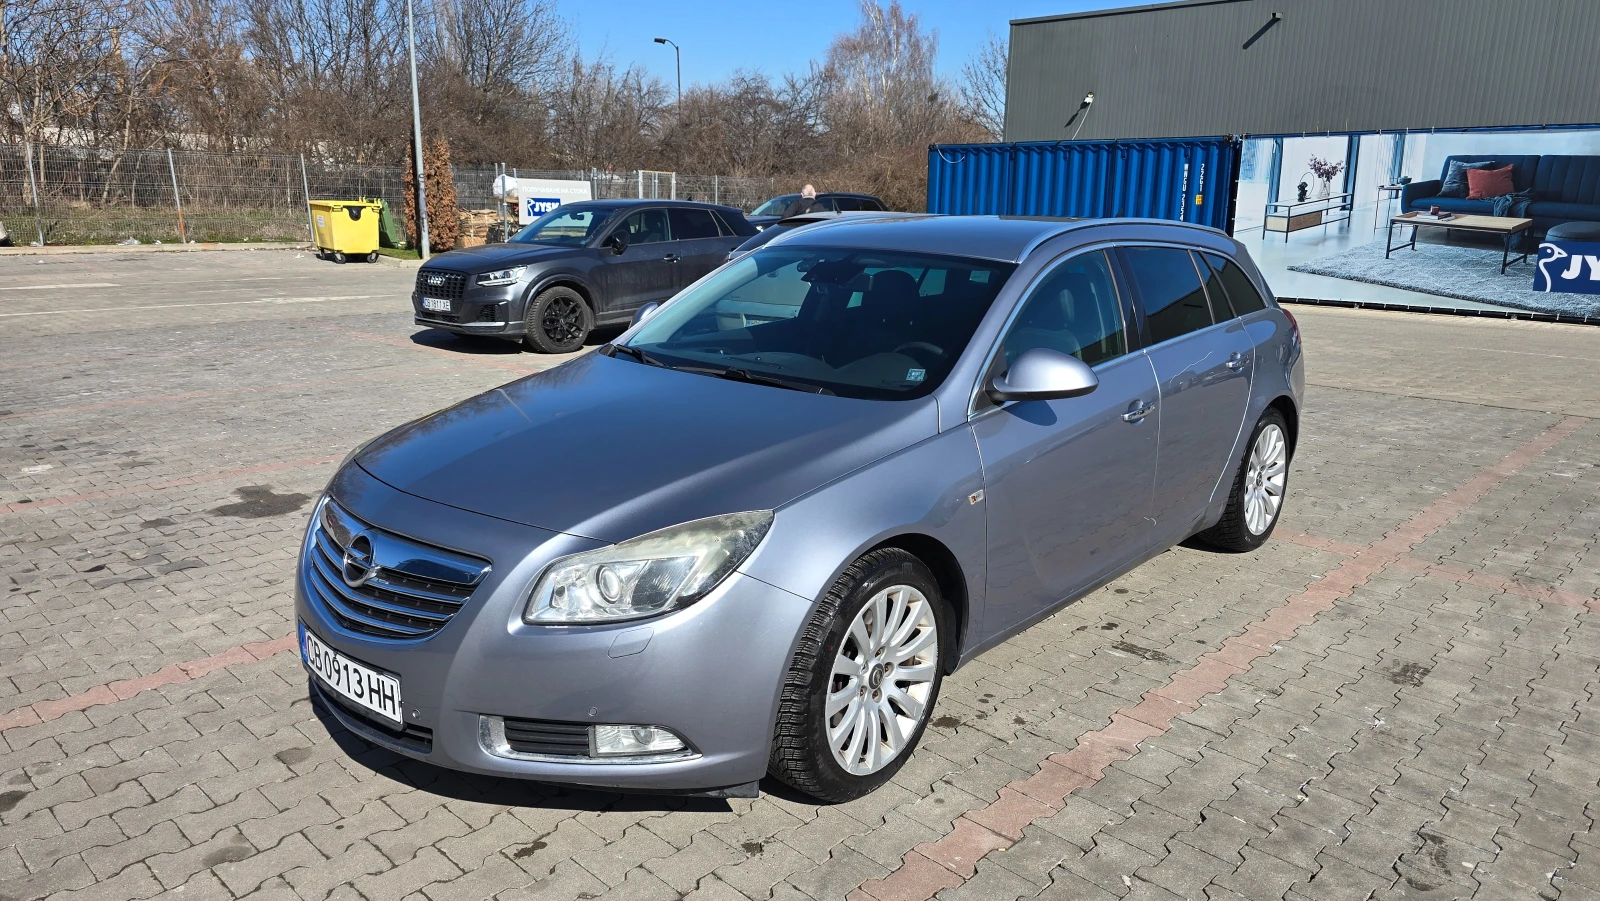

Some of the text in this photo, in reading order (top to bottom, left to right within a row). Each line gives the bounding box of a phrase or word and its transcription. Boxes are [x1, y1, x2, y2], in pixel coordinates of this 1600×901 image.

[522, 186, 560, 194] ПОЛУЧАВАНЕ
[306, 635, 396, 715] CB 0913 HH
